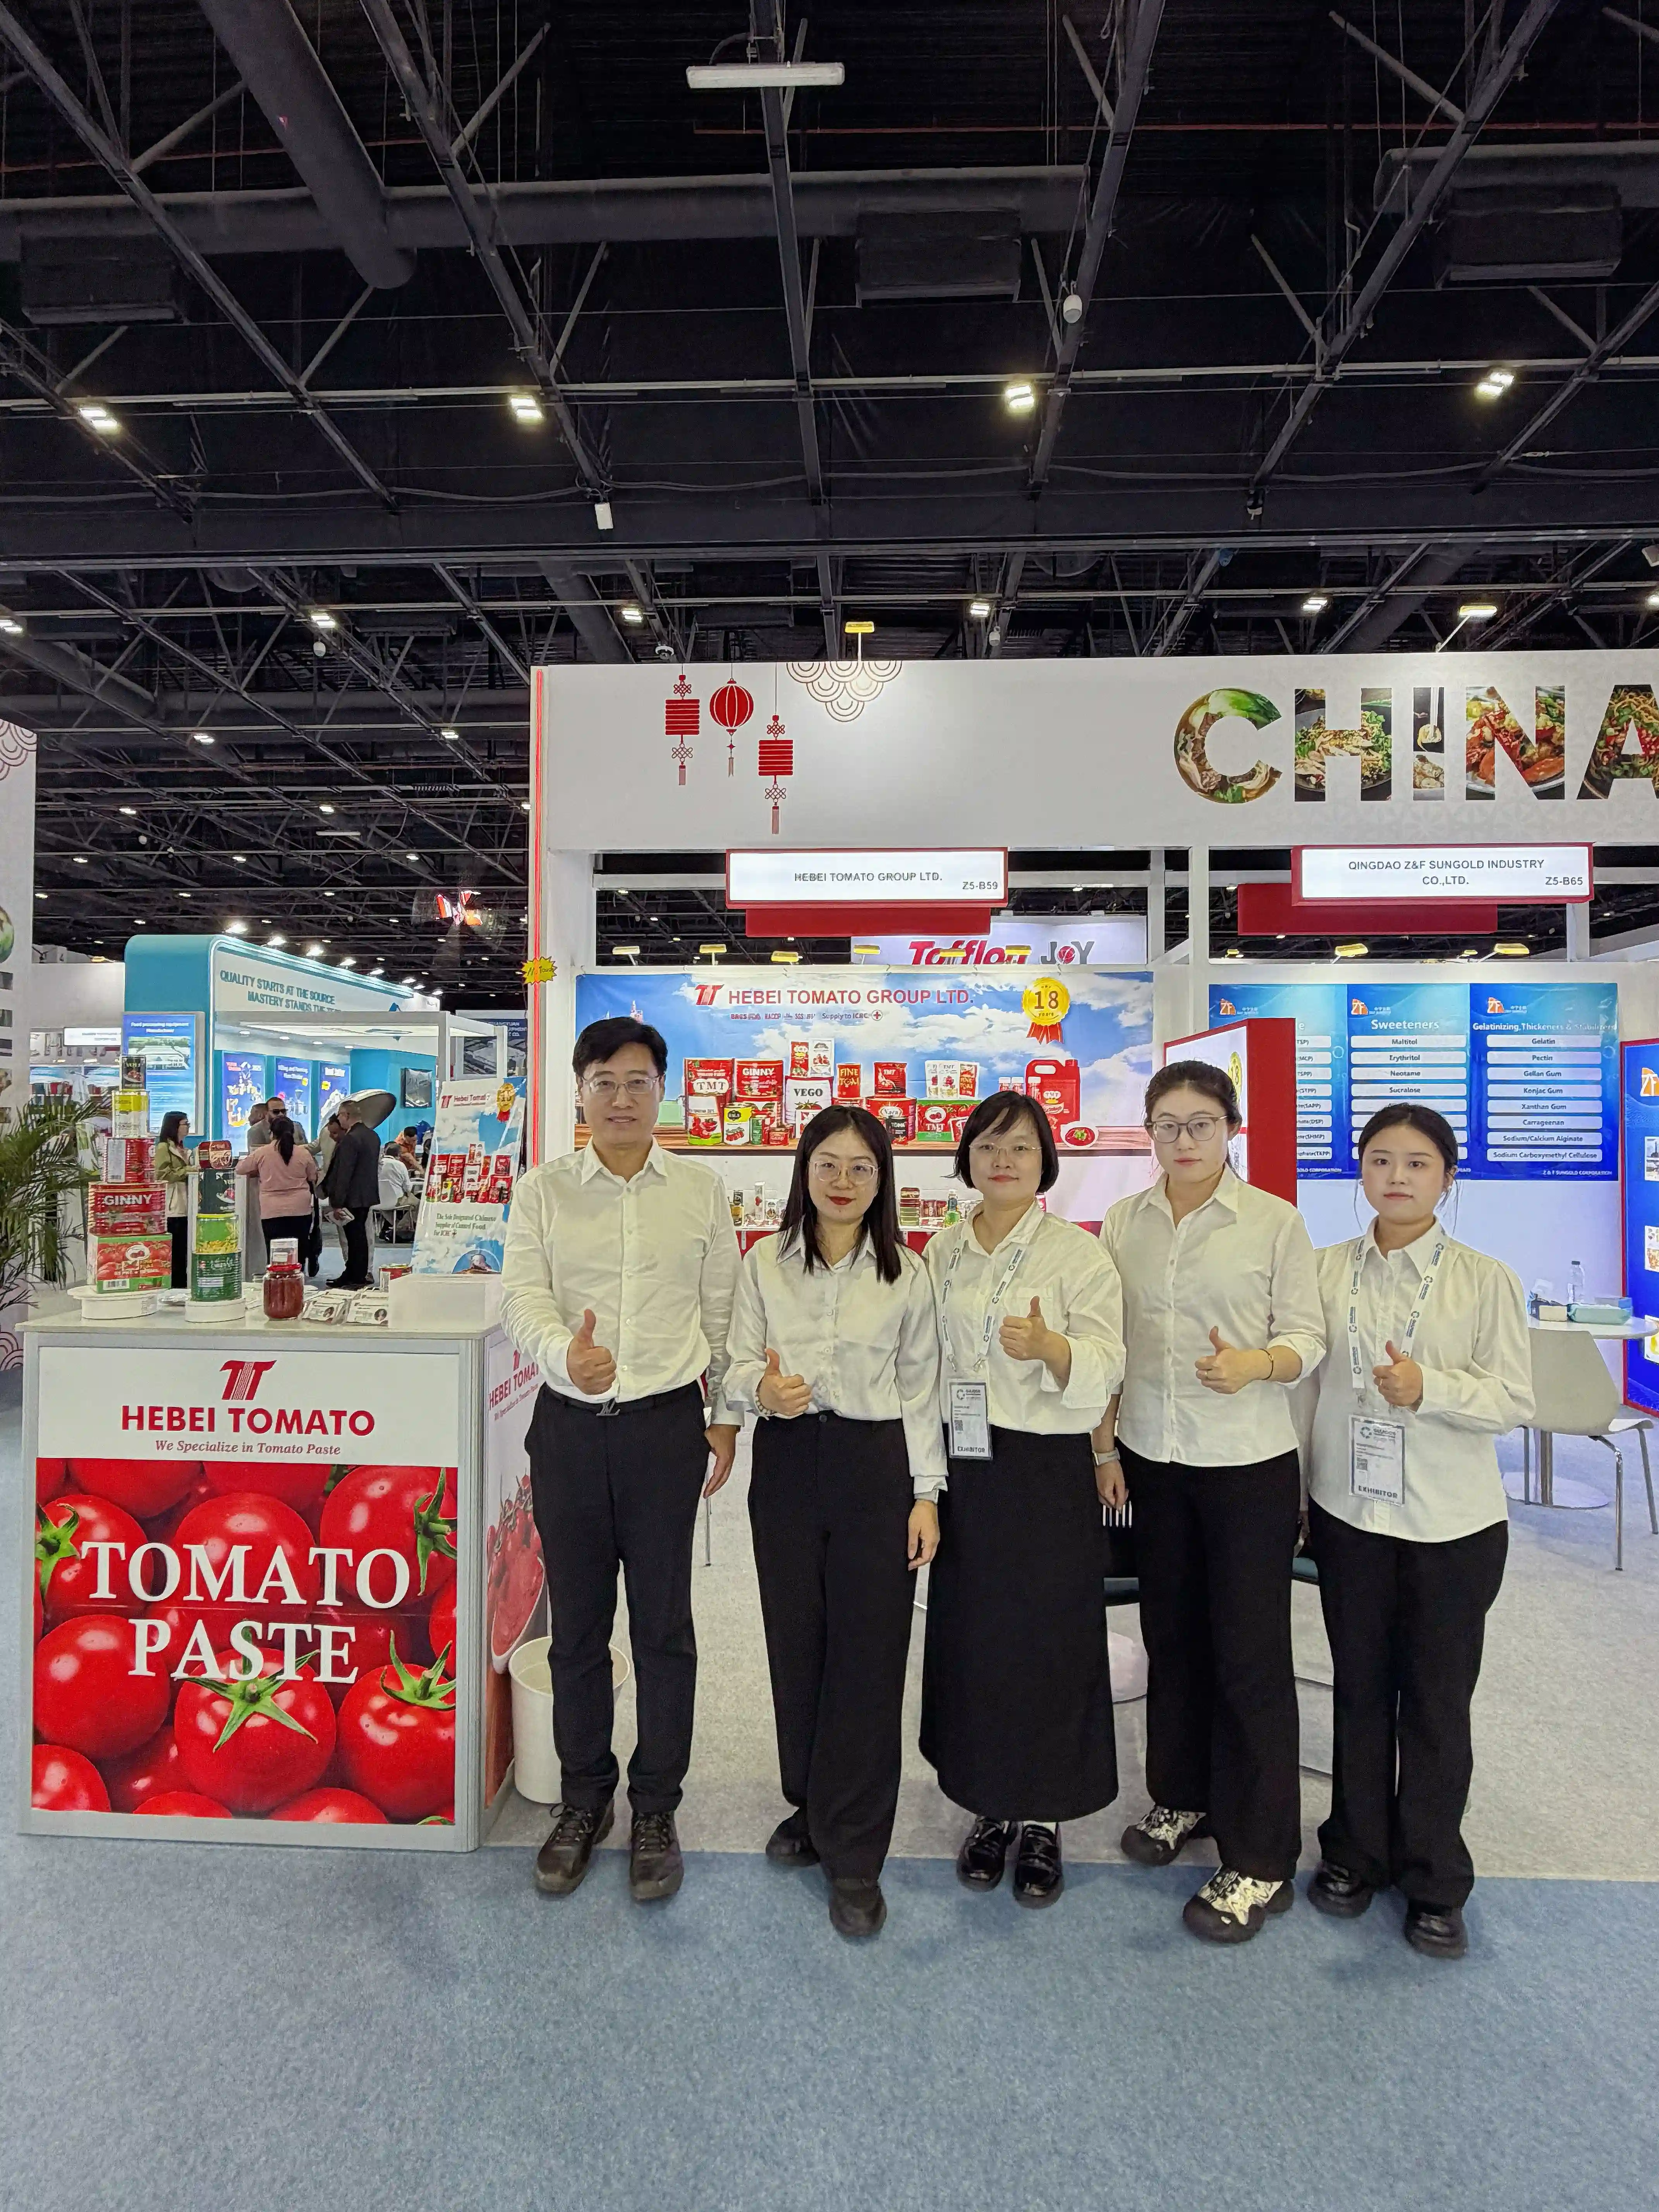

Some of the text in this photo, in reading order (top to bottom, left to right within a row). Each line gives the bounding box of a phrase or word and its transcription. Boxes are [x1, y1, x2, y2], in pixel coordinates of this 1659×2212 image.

[1174, 684, 1659, 804] CHINA
[1349, 860, 1544, 870] QINGDAO Z&F SUNGOLD INDUSTRY
[795, 872, 943, 881] HEBEI TOMATO GROUP LTD.
[1422, 876, 1583, 886] CO.,LTD. Z5-B65
[962, 881, 998, 890] Z5-B59
[220, 970, 336, 1005] QUALITY STARTS AT THE SOURCE
[247, 991, 284, 1007] MASTERY
[729, 990, 781, 1004] HEBEI
[787, 990, 861, 1004] TOMATO
[866, 989, 931, 1004] GROUP
[936, 989, 974, 1004] LTD.
[1034, 991, 1059, 1010] 18
[1371, 1019, 1440, 1030] Sweeteners
[742, 1067, 775, 1076] GINNY
[697, 1082, 726, 1090] TMT
[793, 1089, 823, 1097] VEGO
[103, 1194, 153, 1205] GINNY
[489, 1377, 511, 1411] HEBEI
[122, 1405, 375, 1436] HEBEI TOMATO
[156, 1439, 341, 1455] We Specialize in Tomato Paste
[1358, 1485, 1398, 1499] EXHIBITOR
[81, 1541, 410, 1609] TOMATO
[128, 1618, 359, 1684] PASTE
